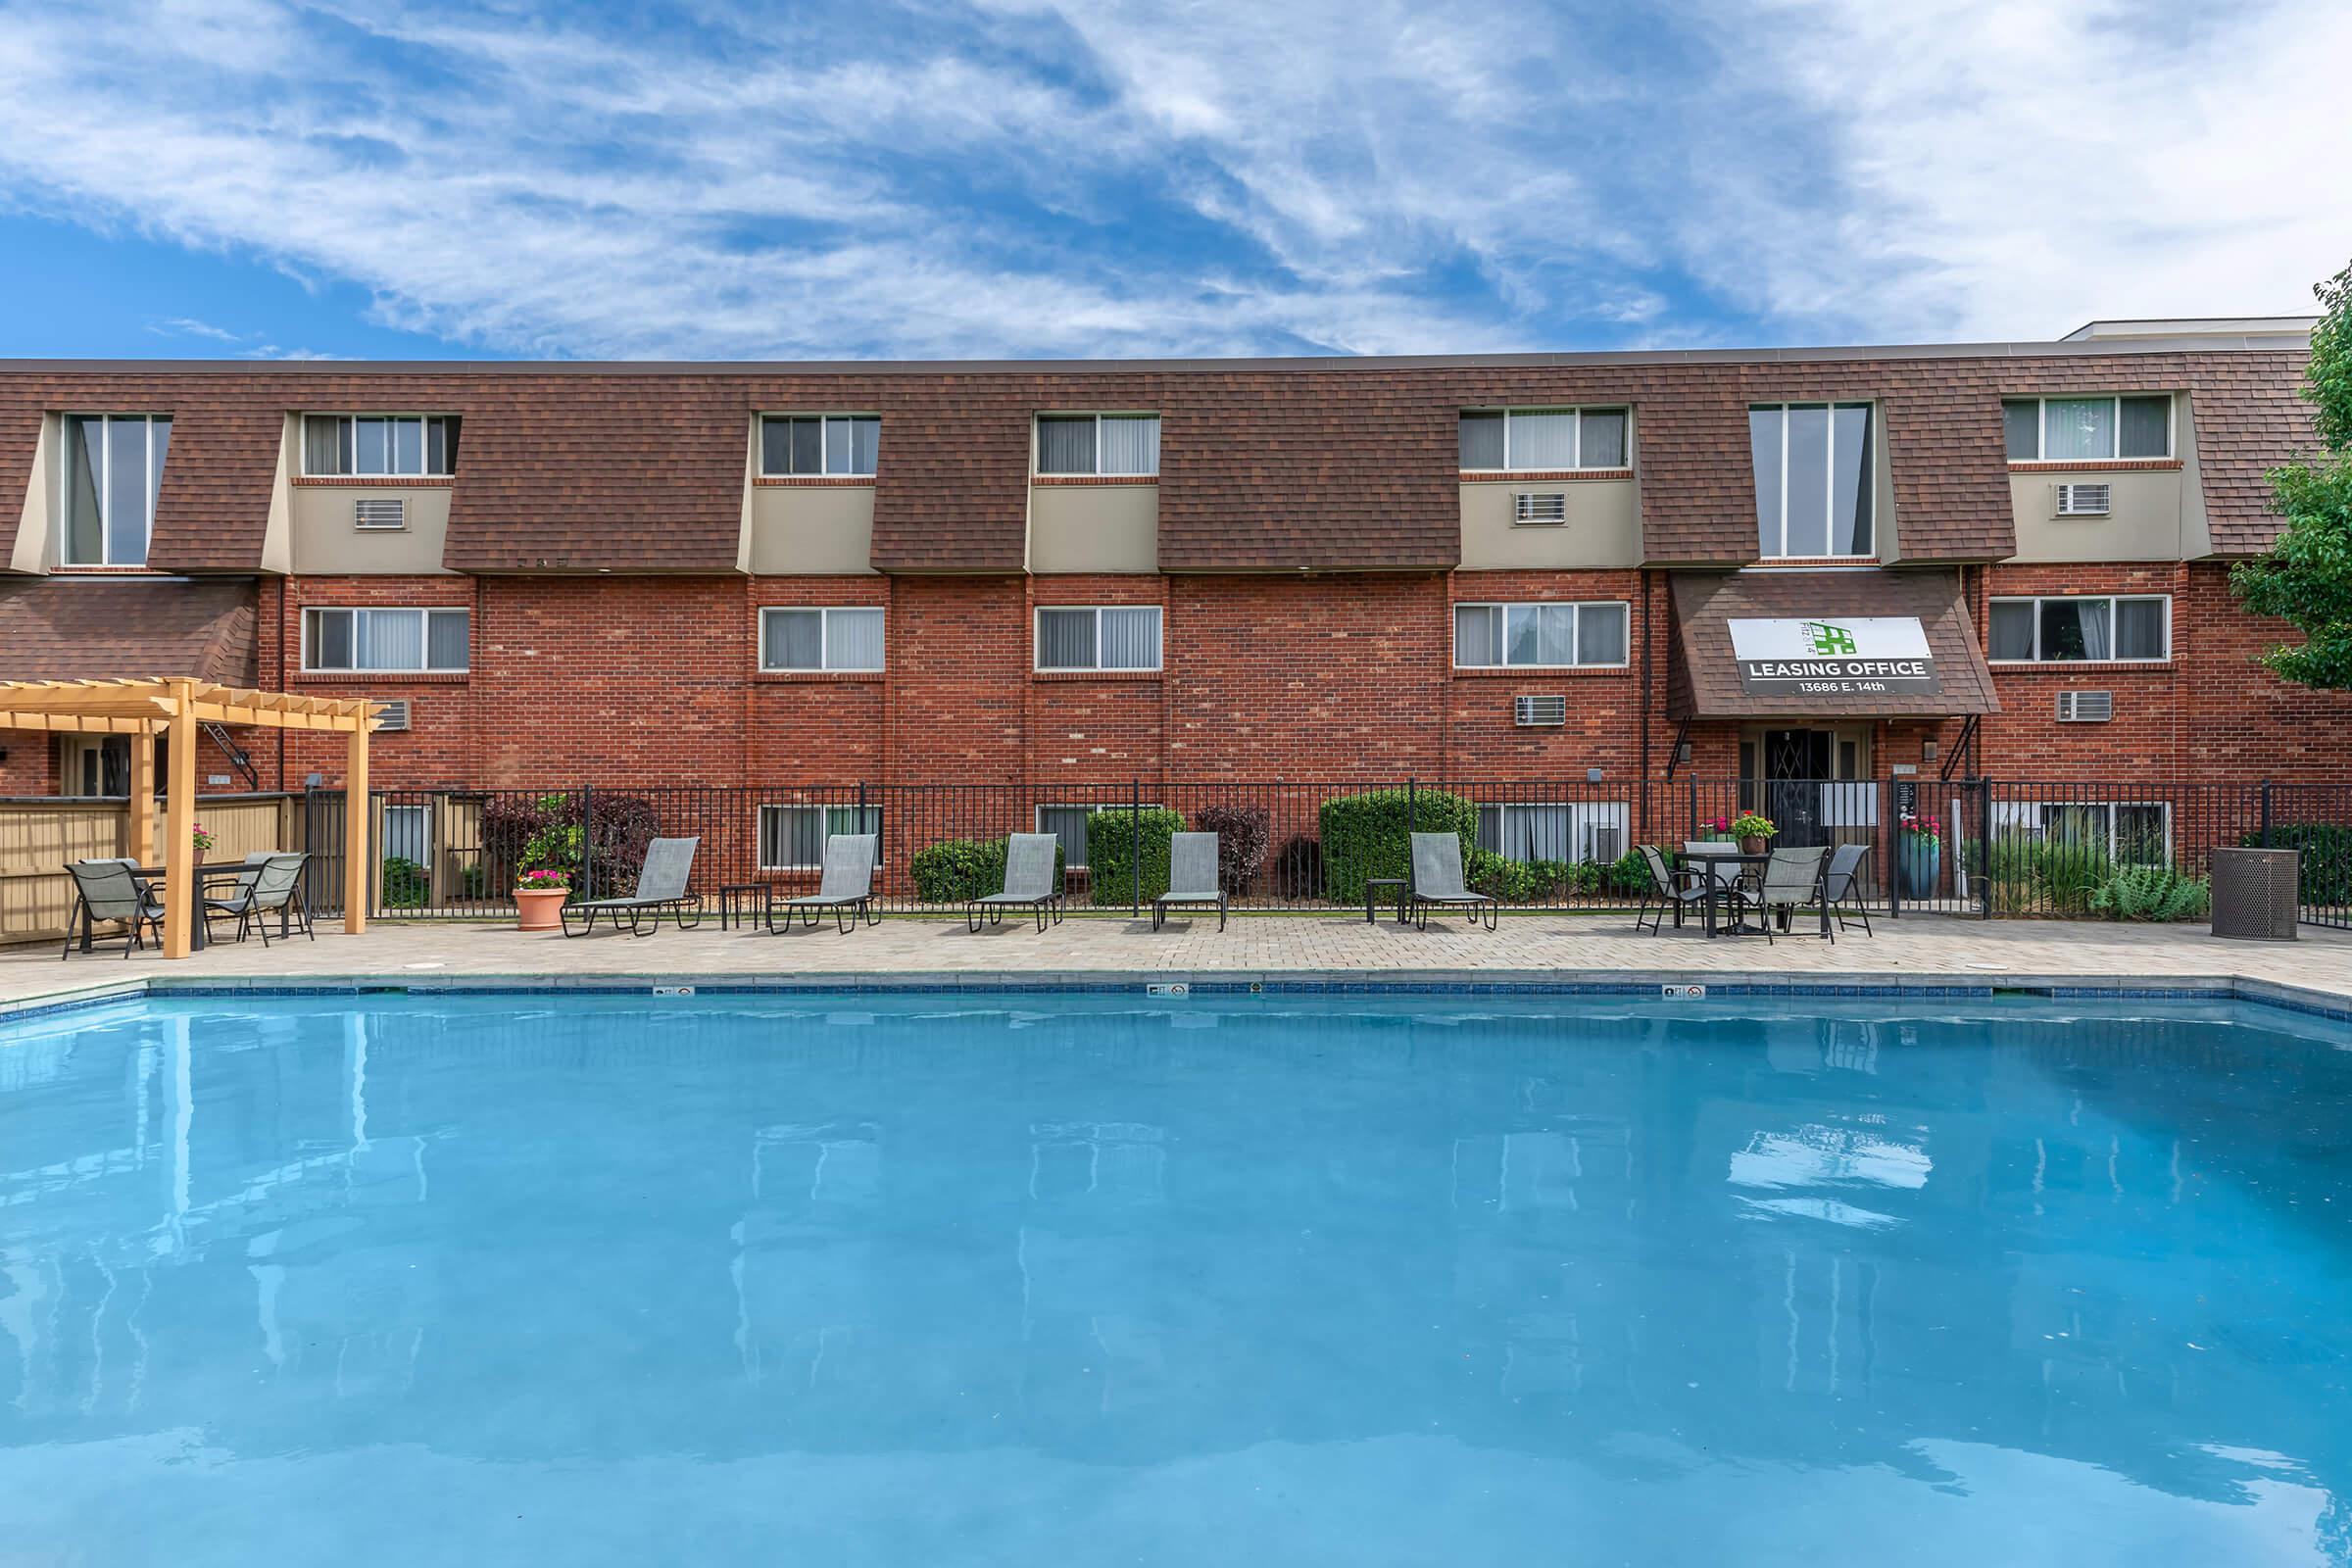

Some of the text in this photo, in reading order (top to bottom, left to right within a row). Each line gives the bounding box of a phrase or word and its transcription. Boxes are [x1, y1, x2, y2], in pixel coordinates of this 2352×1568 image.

[1749, 662, 1926, 676] LEASING OFFICE
[1799, 681, 1886, 692] 13686 E. 14th
